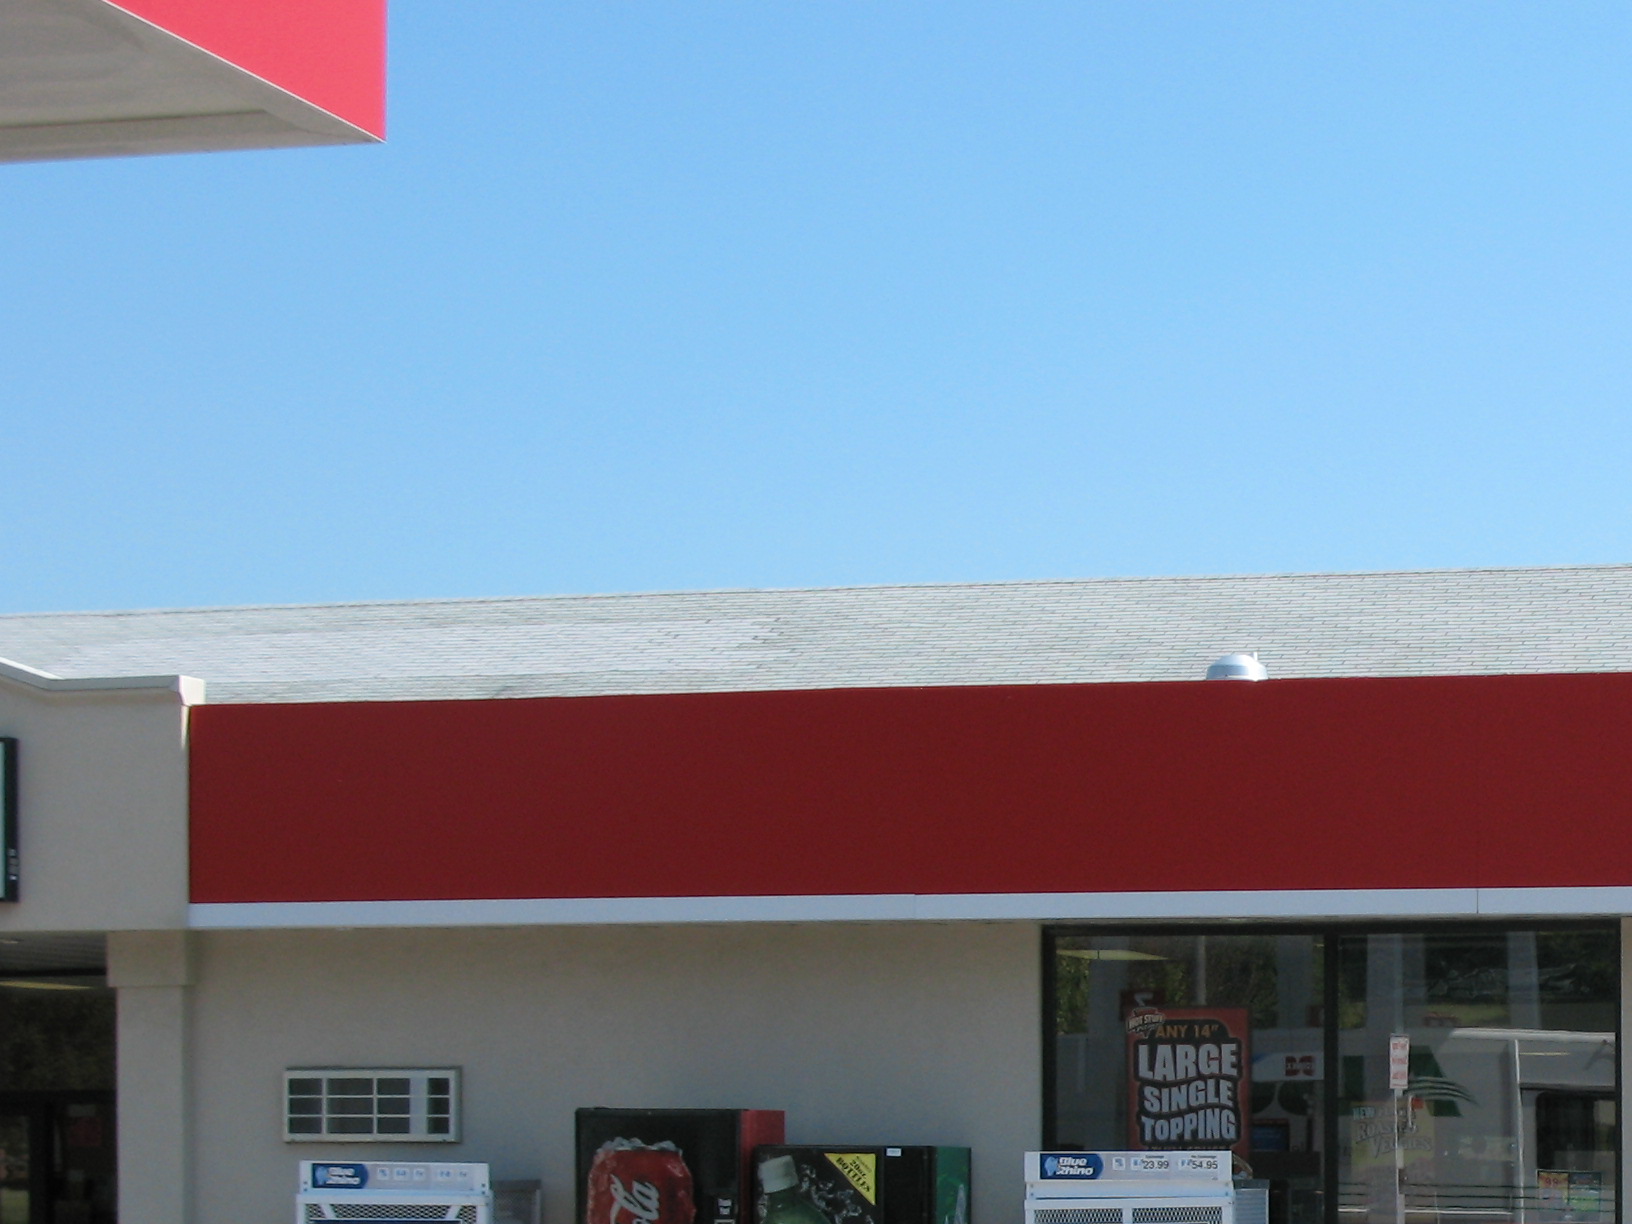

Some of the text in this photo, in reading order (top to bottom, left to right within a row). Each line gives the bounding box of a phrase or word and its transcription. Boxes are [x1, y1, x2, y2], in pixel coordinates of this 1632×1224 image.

[1155, 1025, 1187, 1038] ANY
[1194, 1024, 1220, 1038] 14"
[1138, 1043, 1238, 1081] LARGE
[1143, 1078, 1234, 1114] SINGLE
[1141, 1108, 1237, 1142] TOPPING
[1056, 1166, 1094, 1176] Rhino
[1059, 1156, 1088, 1167] Blue
